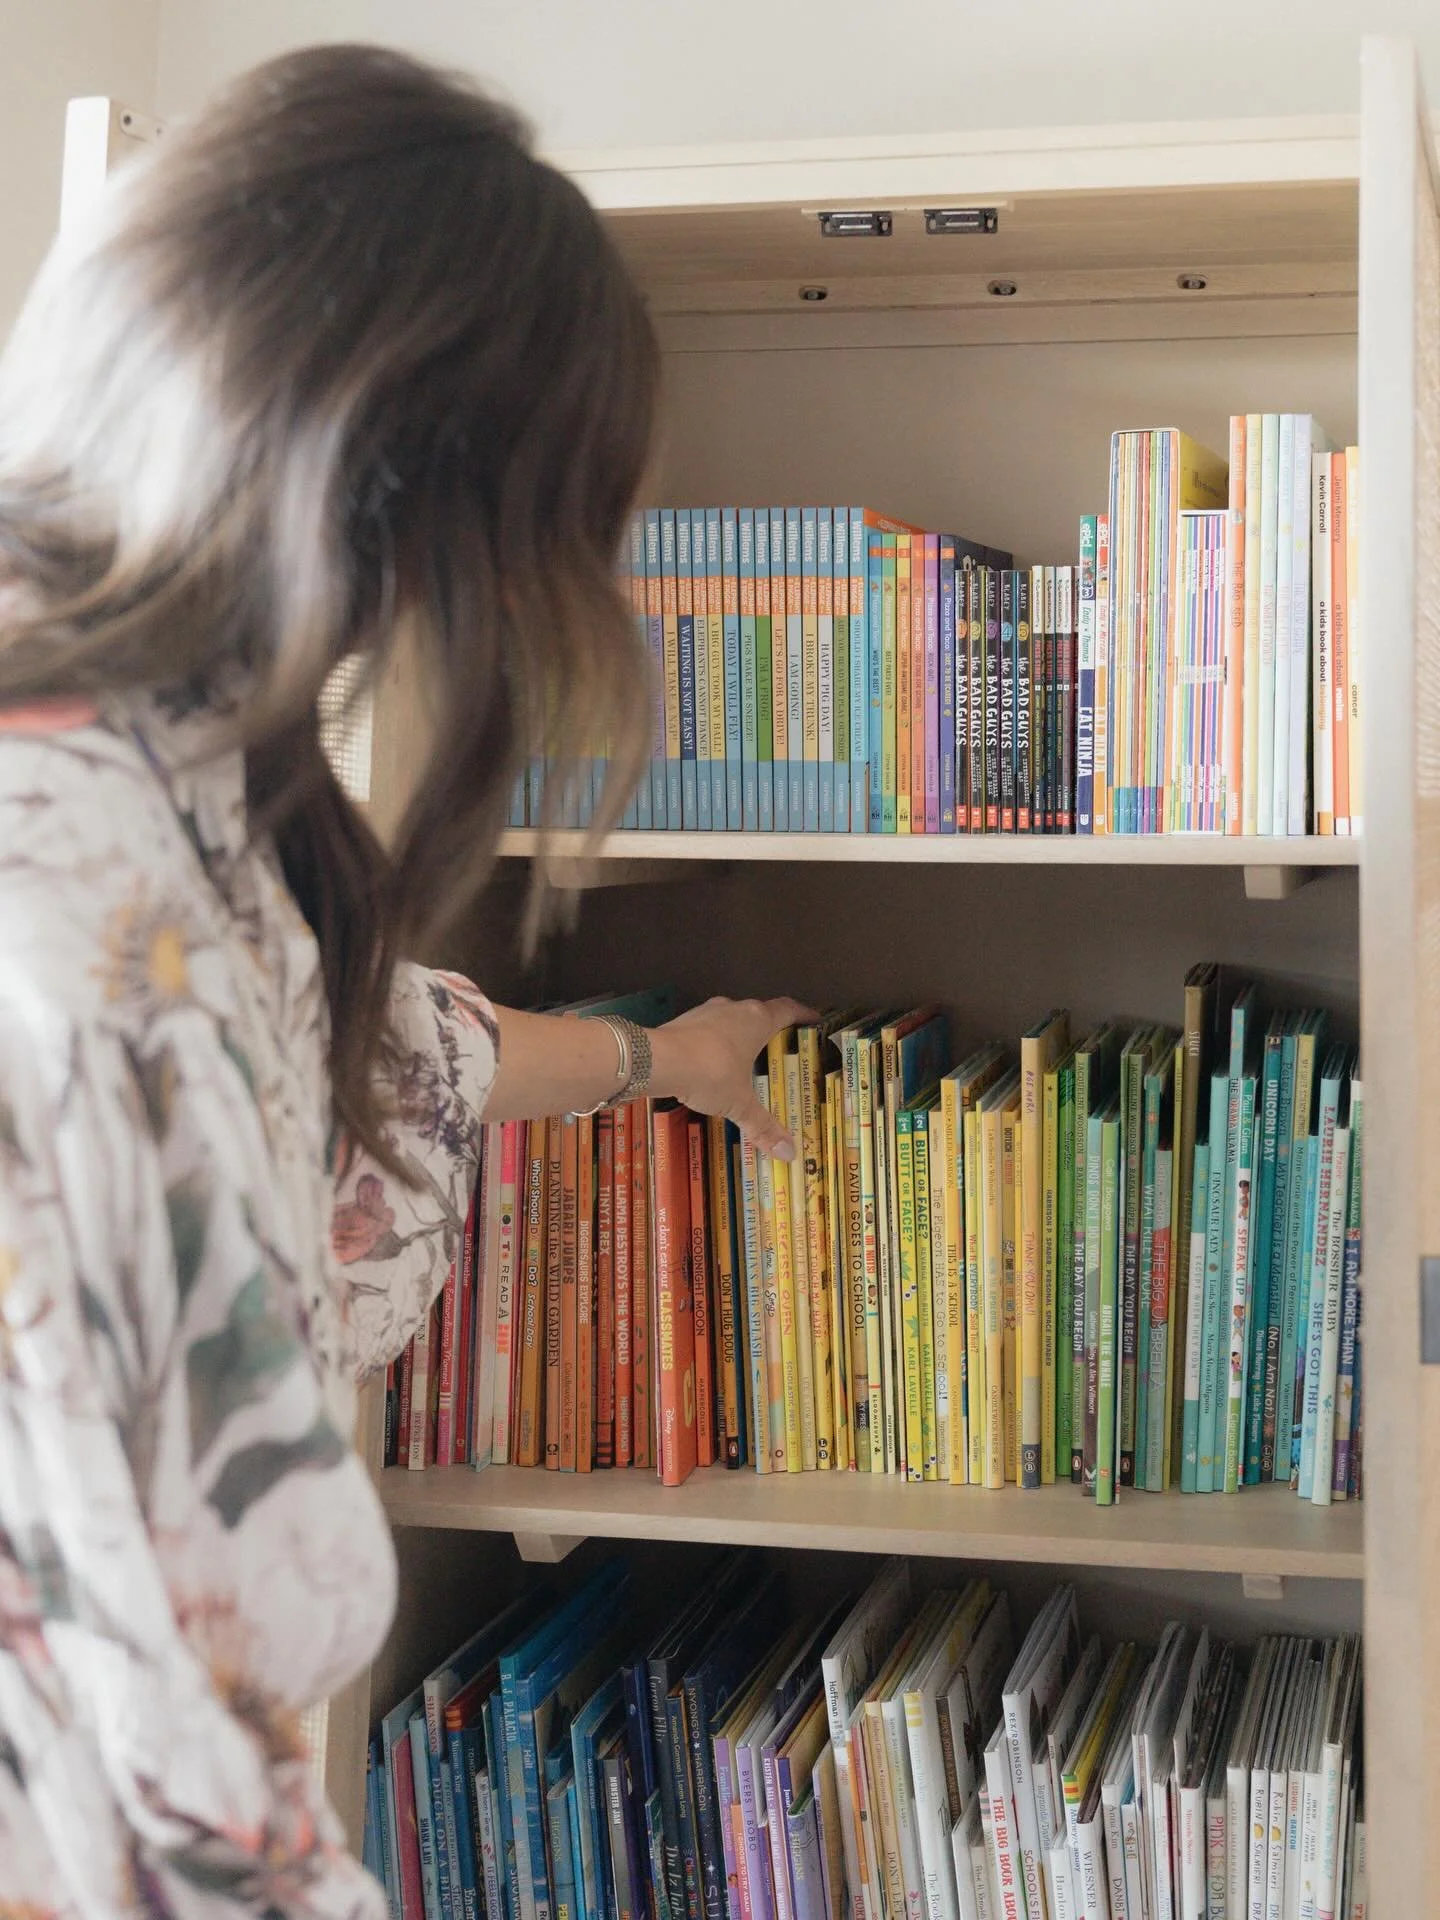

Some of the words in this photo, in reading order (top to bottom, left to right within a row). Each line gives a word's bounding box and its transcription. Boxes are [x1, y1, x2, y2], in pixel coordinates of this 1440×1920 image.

[1319, 502, 1327, 533] Carroll
[664, 521, 674, 562] Willems
[694, 522, 704, 563] Willems
[725, 520, 736, 562] Willems
[756, 523, 767, 564] Willems
[788, 520, 799, 562] Willems
[820, 522, 830, 563] Willems
[852, 520, 862, 562] Willems
[681, 625, 690, 673] WAITING
[697, 619, 706, 676] ELEPHANTS
[727, 630, 736, 669] TODAY
[821, 644, 830, 680] HAPPY
[958, 654, 967, 671] the
[987, 655, 997, 671] the
[745, 658, 753, 683] MAKE
[971, 656, 980, 673] the
[1002, 657, 1012, 674] the
[1019, 657, 1029, 673] the
[683, 677, 691, 687] IS
[698, 679, 706, 716] CANNOT
[728, 680, 737, 712] WILL
[745, 686, 753, 701] ME
[822, 684, 830, 702] PIG
[956, 675, 966, 704] BAD
[971, 677, 981, 705] BAD
[987, 676, 997, 704] BAD
[1002, 678, 1012, 707] BAD
[1018, 678, 1029, 706] BAD
[683, 695, 691, 714] NOT
[822, 707, 830, 732] DAY!
[684, 717, 693, 750] EASY!
[699, 720, 708, 756] DANCE!
[729, 716, 739, 740] FLY!
[956, 707, 967, 746] GUYS
[970, 709, 981, 747] GUYS
[986, 708, 997, 746] GUYS
[1001, 711, 1012, 749] GUYS
[1017, 710, 1029, 748] GUYS
[1078, 736, 1092, 777] NINJA
[802, 1059, 810, 1092] SHAREE
[846, 1048, 854, 1087] Shannon
[1265, 1079, 1278, 1134] UNICORN
[1264, 1138, 1274, 1162] DAY
[1322, 1106, 1335, 1164] LAURIE
[530, 1159, 541, 1186] What
[900, 1143, 911, 1178] BUTT
[916, 1140, 926, 1175] BUTT
[549, 1161, 560, 1232] PLANTING
[849, 1163, 859, 1203] DAVID
[902, 1182, 910, 1194] OR
[918, 1179, 925, 1192] OR
[1210, 1172, 1221, 1225] DINOSAUR
[530, 1189, 540, 1224] Should
[563, 1187, 575, 1234] JABARI
[616, 1184, 627, 1224] LLAMA
[659, 1208, 667, 1225] we
[918, 1197, 928, 1240] FACE?
[1316, 1168, 1331, 1265] HERNANDEZ
[851, 1211, 861, 1246] GOES
[902, 1200, 913, 1243] FACE?
[549, 1238, 560, 1259] the
[579, 1221, 589, 1282] DIGGERSAURS
[659, 1227, 670, 1250] don't
[1074, 1243, 1083, 1263] THE
[1125, 1244, 1134, 1263] THE
[1209, 1228, 1219, 1255] LADY
[1236, 1228, 1247, 1271] SPEAK
[563, 1240, 574, 1284] JUMPS
[616, 1228, 628, 1292] DESTROYS
[660, 1252, 668, 1268] eat
[693, 1227, 704, 1296] GOODNIGHT
[852, 1255, 861, 1270] TO
[1153, 1243, 1165, 1272] THE
[1345, 1260, 1356, 1284] AM
[549, 1264, 560, 1301] WILD
[661, 1270, 669, 1288] our
[722, 1274, 732, 1304] DON'T
[1074, 1268, 1083, 1288] DAY
[1125, 1268, 1135, 1289] DAY
[1153, 1279, 1164, 1301] BIG
[1236, 1278, 1244, 1295] UP
[580, 1285, 589, 1323] EXPLORE
[618, 1295, 628, 1315] THE
[696, 1301, 705, 1336] MOON
[724, 1309, 733, 1329] HUG
[853, 1275, 865, 1336] SCHOOL.
[1074, 1294, 1083, 1316] YOU
[1125, 1294, 1135, 1317] YOU
[1344, 1288, 1356, 1325] MORE
[549, 1307, 560, 1367] GARDEN
[660, 1291, 673, 1371] CLASSMATES
[1073, 1321, 1083, 1351] BEGIN
[1124, 1322, 1134, 1352] BEGIN
[1311, 1302, 1323, 1341] SHE'S
[618, 1320, 628, 1364] WORLD
[725, 1334, 734, 1363] DOUG
[923, 1344, 932, 1367] KARI
[1151, 1305, 1165, 1392] UMBRELLA
[1342, 1329, 1354, 1365] THAN
[907, 1346, 916, 1371] KARI
[1310, 1347, 1321, 1376] GOT
[909, 1375, 917, 1416] LAVELLE
[925, 1371, 933, 1412] LAVELLE
[1307, 1384, 1319, 1414] THIS
[829, 1681, 839, 1717] Hoffman
[427, 1696, 438, 1753] SHANNON
[672, 1716, 680, 1743] Amanda
[673, 1745, 682, 1773] Gorman
[688, 1688, 700, 1738] NYONG'O
[694, 1752, 706, 1811] HARRISON
[1009, 1712, 1023, 1784] REX/ROBINSON
[610, 1776, 619, 1808] MONSTER
[678, 1780, 686, 1799] Loren
[1255, 1789, 1264, 1819] RUBIN
[613, 1810, 621, 1824] JAM
[679, 1801, 687, 1818] Long
[742, 1770, 752, 1803] BYERS
[747, 1820, 757, 1851] BOBO
[993, 1797, 1004, 1821] THE
[1273, 1791, 1284, 1823] Rubin
[996, 1828, 1007, 1849] BIG
[1210, 1816, 1224, 1848] PINK
[423, 1845, 432, 1865] LADY
[887, 1852, 899, 1888] DON'T
[1000, 1854, 1012, 1886] BOOK
[1254, 1843, 1263, 1885] SALMIERI
[1271, 1845, 1281, 1889] Salmieri
[1024, 1849, 1037, 1907] SCHOOL'S
[1083, 1851, 1096, 1909] WIESNER
[892, 1893, 904, 1914] LET
